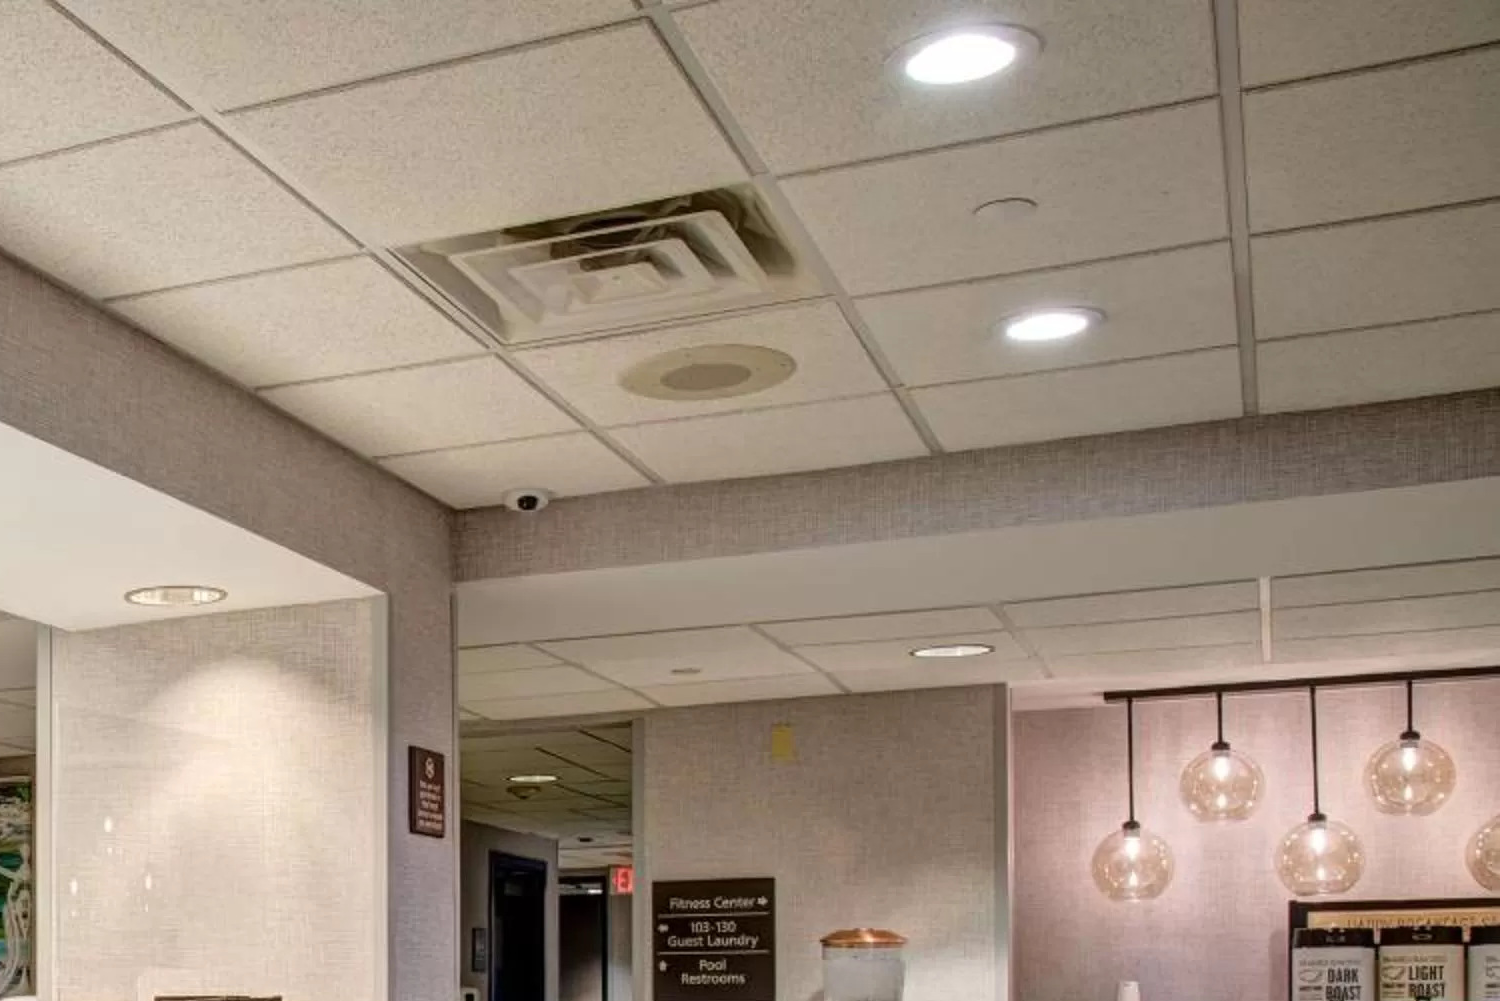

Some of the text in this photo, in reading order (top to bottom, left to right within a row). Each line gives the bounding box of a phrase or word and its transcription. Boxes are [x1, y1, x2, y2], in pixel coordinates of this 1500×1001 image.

[669, 896, 756, 910] Fitness Center
[667, 934, 759, 949] Guest Laundry
[699, 959, 727, 971] Pool
[681, 972, 746, 985] Restrooms
[1327, 968, 1359, 983] DARK
[1408, 965, 1445, 981] LIGHT
[1326, 985, 1361, 1001] ROAST
[1407, 982, 1446, 999] ROAST
